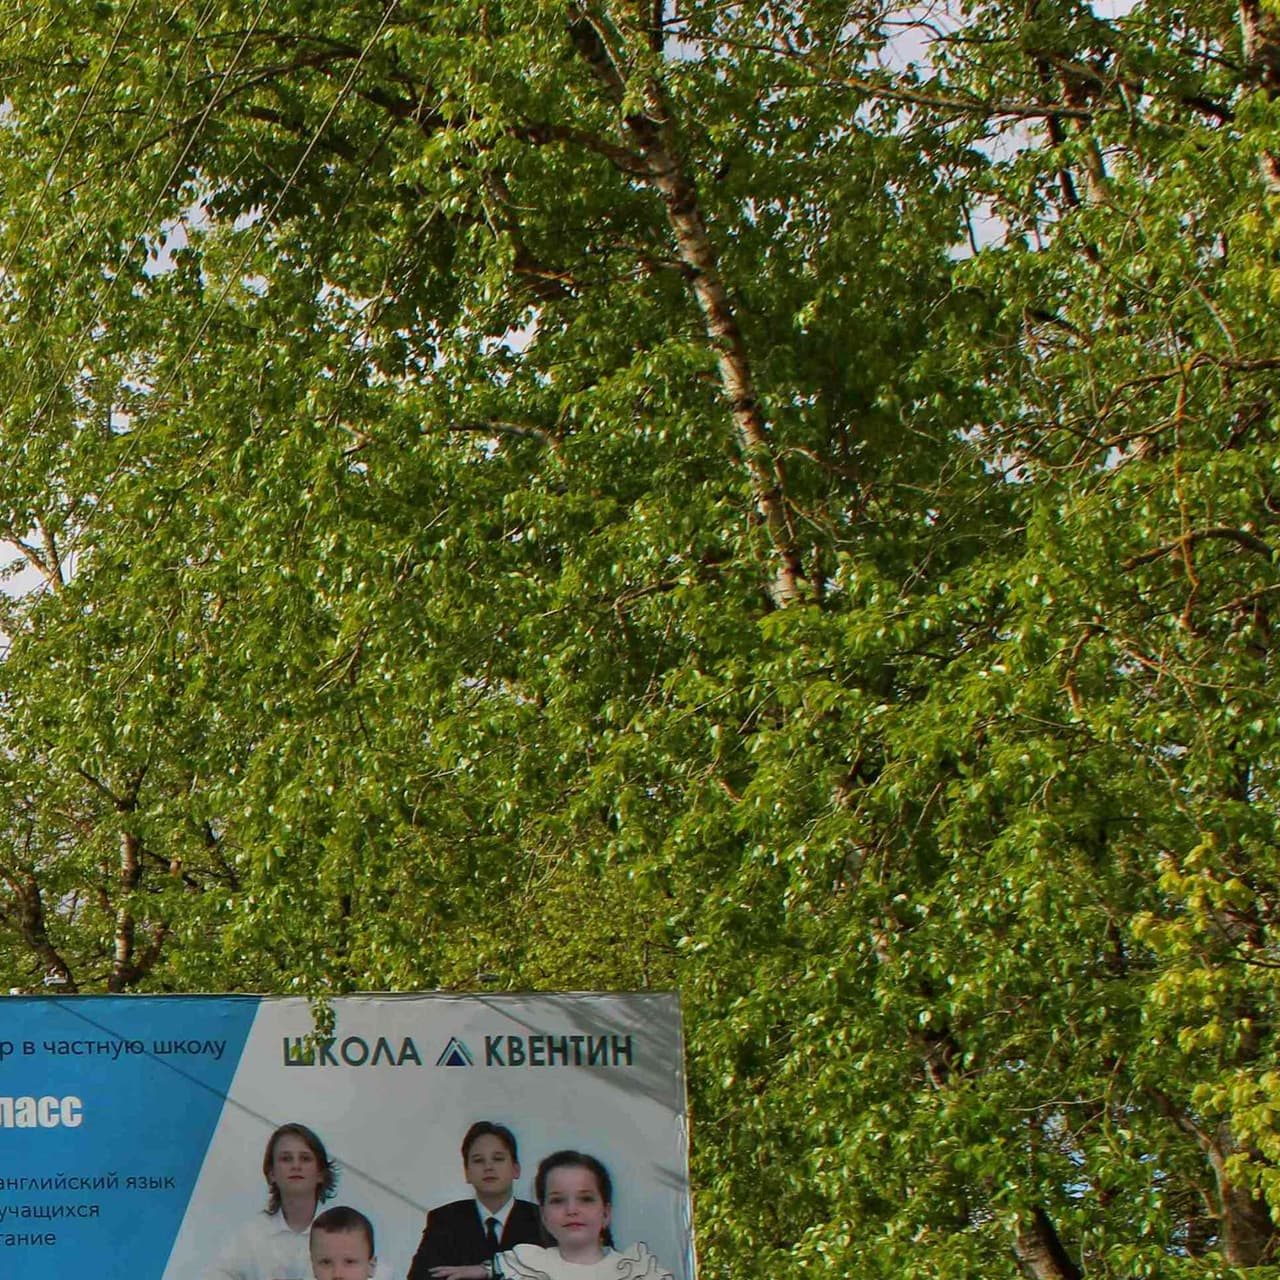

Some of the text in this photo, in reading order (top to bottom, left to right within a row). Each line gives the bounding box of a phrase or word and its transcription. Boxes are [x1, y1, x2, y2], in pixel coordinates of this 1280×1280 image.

[23, 1042, 36, 1055] в
[44, 1039, 145, 1061] частную
[153, 1039, 227, 1060] школу
[283, 1035, 633, 1067] ШКОЛА КВЕНТИН
[126, 1175, 176, 1190] язык
